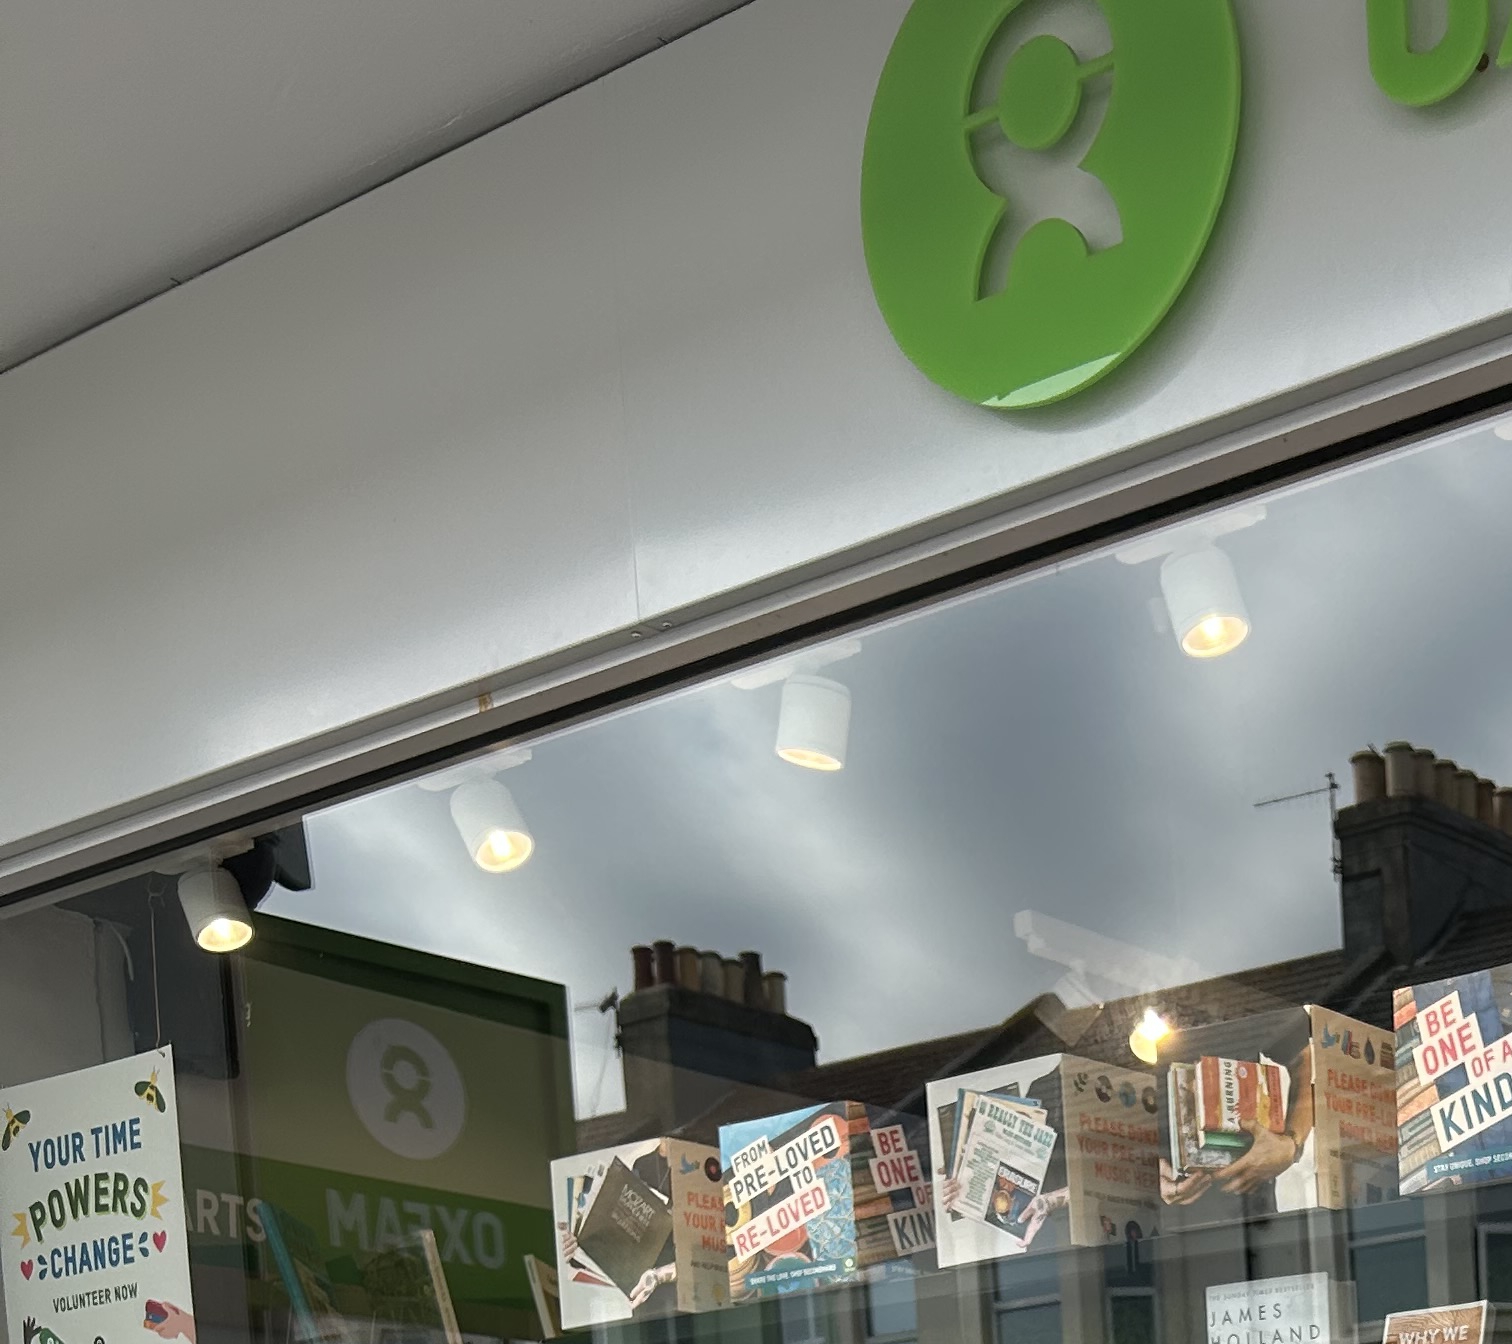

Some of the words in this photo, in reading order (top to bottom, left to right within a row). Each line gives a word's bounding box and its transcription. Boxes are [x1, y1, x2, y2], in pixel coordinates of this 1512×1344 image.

[1425, 1001, 1457, 1037] BE
[1422, 1023, 1477, 1076] ONE
[1223, 1061, 1236, 1114] BURNING
[28, 1131, 85, 1173] YOUR
[91, 1118, 142, 1156] TIME
[733, 1141, 768, 1172] FROM
[734, 1124, 836, 1203] PRE-LOVED
[29, 1172, 150, 1243] POWERS
[735, 1186, 826, 1257] RE-LOVED
[51, 1232, 135, 1280] CHANGE
[1209, 1303, 1282, 1328] JAMES
[1443, 1325, 1469, 1342] WE
